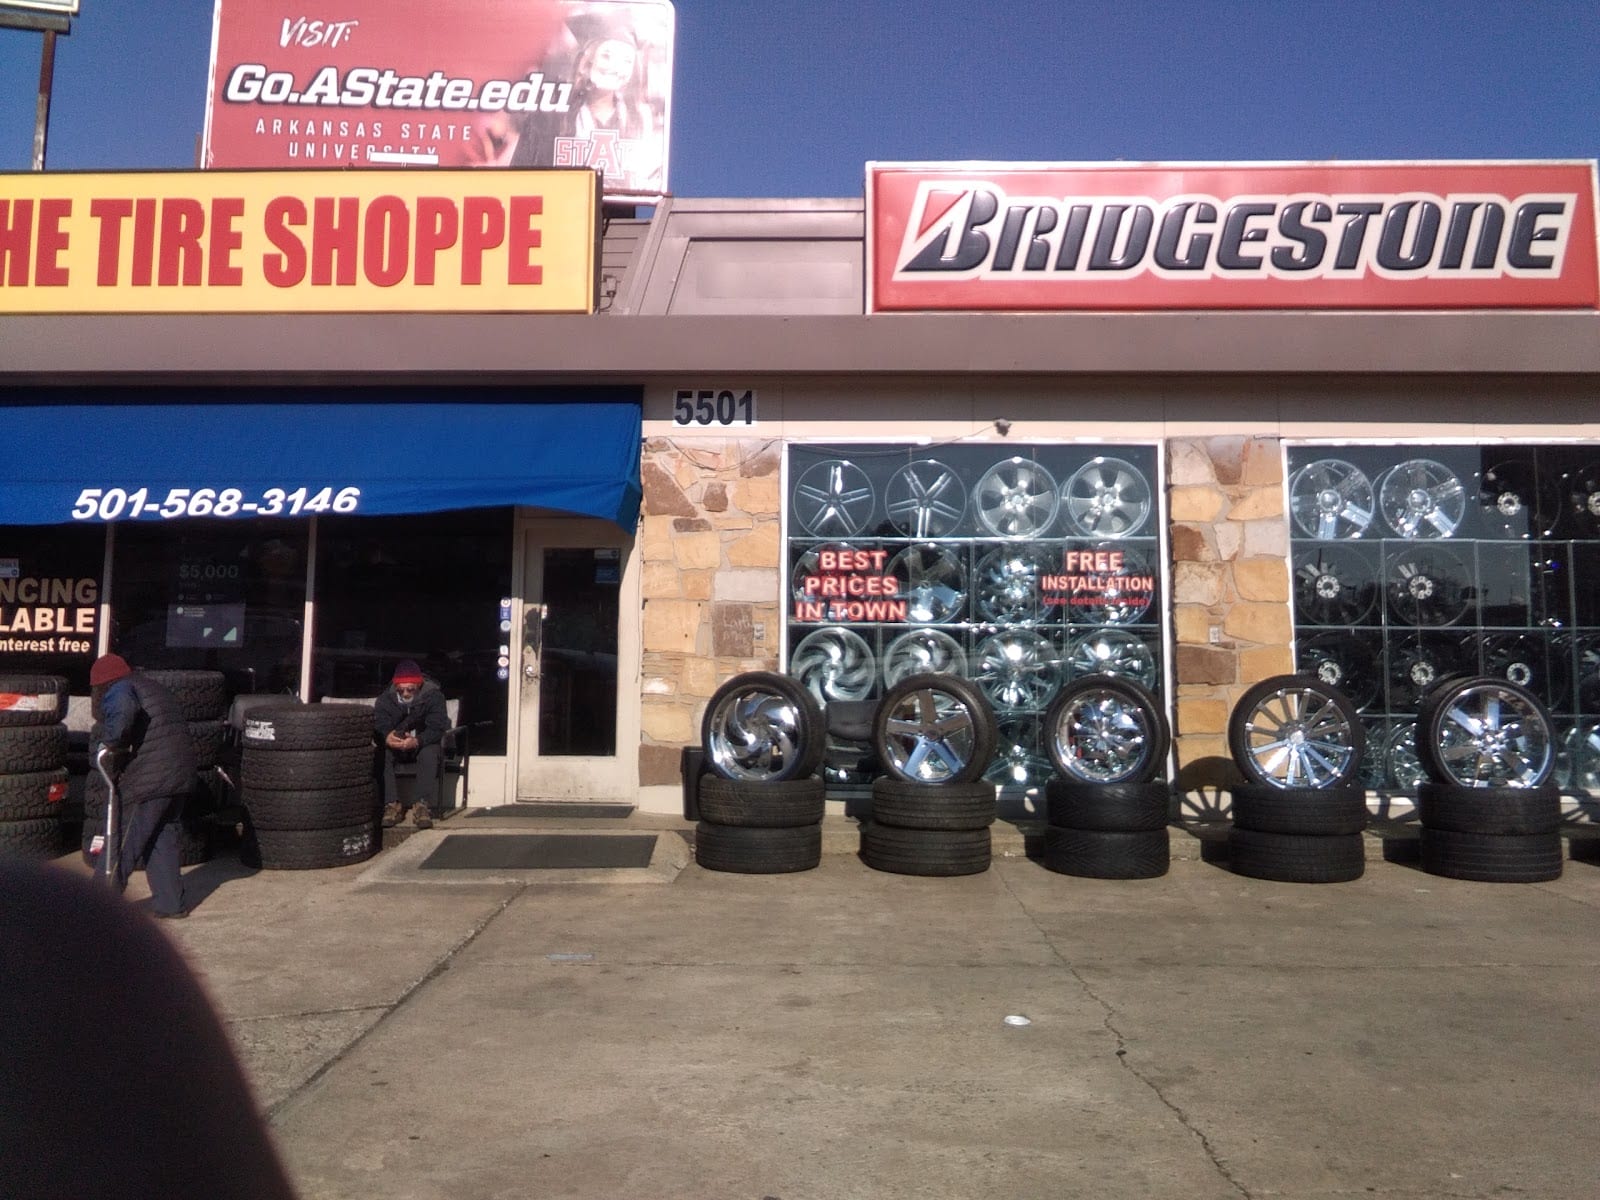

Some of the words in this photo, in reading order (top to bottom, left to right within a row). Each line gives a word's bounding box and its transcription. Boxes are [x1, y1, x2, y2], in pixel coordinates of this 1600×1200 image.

[279, 16, 359, 48] VISIT:
[224, 63, 573, 114] Go.AState.edu
[255, 118, 383, 138] ARKANSAS
[401, 123, 471, 140] STATE
[898, 186, 1567, 273] BRIDGESTONE
[0, 197, 72, 288] HE
[90, 197, 245, 287] TIRE
[262, 194, 543, 288] SHOPPE
[674, 390, 753, 426] 5501
[71, 486, 361, 520] 501-568-3146
[820, 551, 887, 570] BEST
[1066, 551, 1124, 571] FREE
[179, 563, 240, 581] $5,000
[805, 576, 898, 596] PRICES
[1041, 576, 1154, 591] INSTALLATION
[796, 601, 822, 620] IN
[828, 601, 907, 621] TOWN
[58, 637, 90, 652] free
